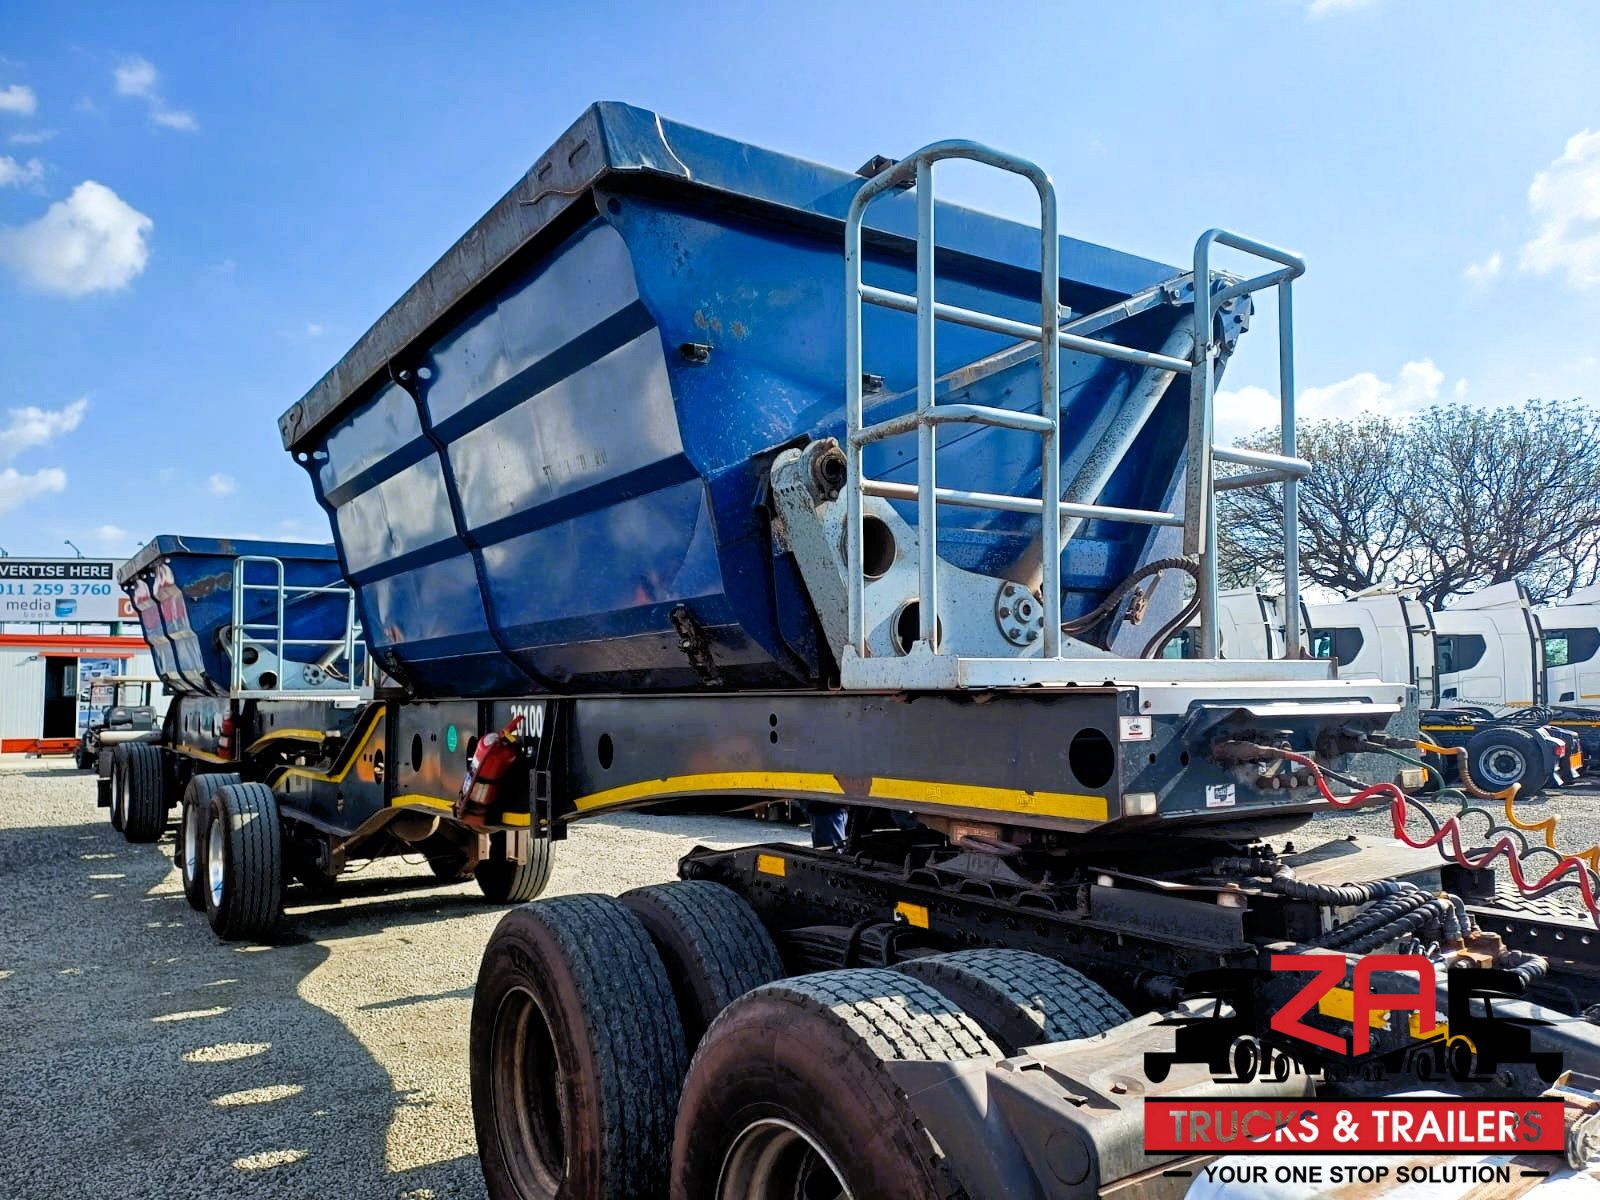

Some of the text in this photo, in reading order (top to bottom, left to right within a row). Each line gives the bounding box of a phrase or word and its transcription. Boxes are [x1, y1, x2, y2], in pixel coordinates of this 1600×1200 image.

[0, 565, 110, 577] VERTISE HERE
[33, 583, 64, 596] 259
[70, 583, 111, 596] 3760
[6, 598, 51, 610] media
[510, 704, 543, 738] 20100
